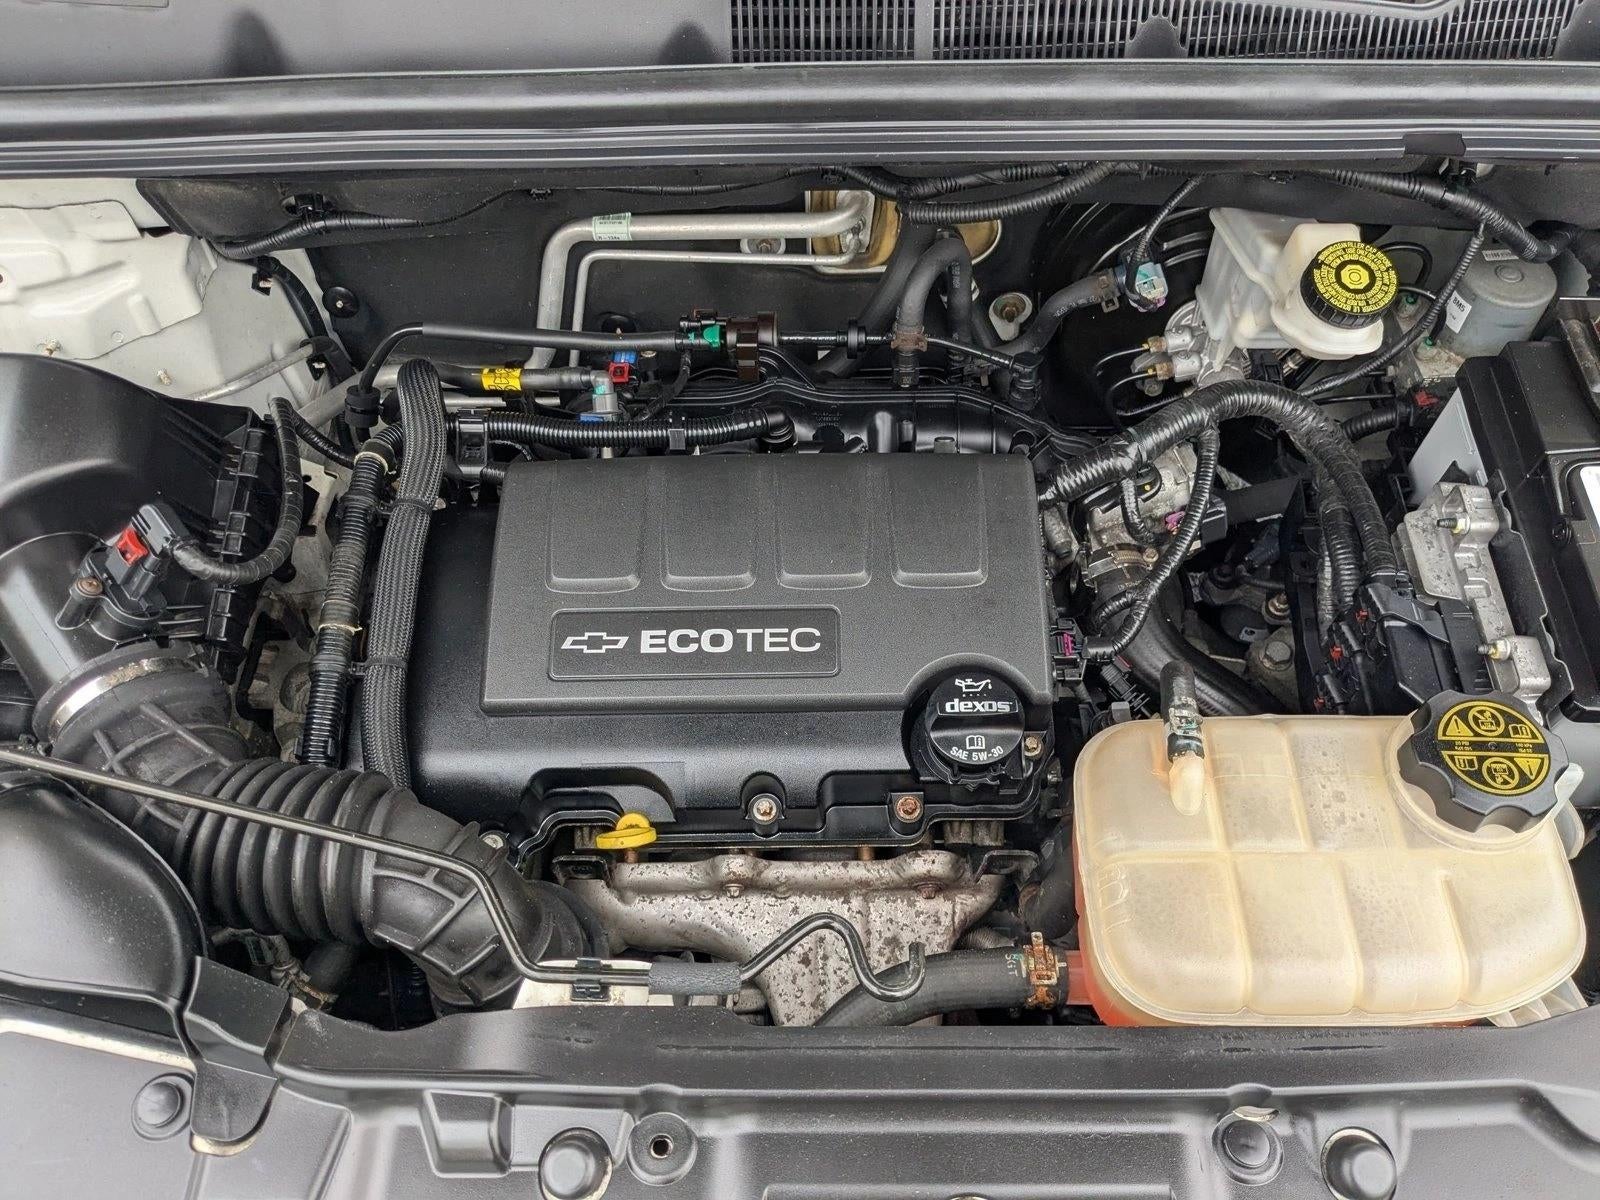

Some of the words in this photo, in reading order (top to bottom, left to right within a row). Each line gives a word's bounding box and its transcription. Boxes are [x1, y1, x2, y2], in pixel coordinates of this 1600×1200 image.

[1365, 245, 1377, 253] CAP
[640, 628, 821, 653] ECOTEC
[945, 698, 1011, 712] dexos
[950, 746, 969, 760] SAE
[972, 745, 1004, 761] 5W-30
